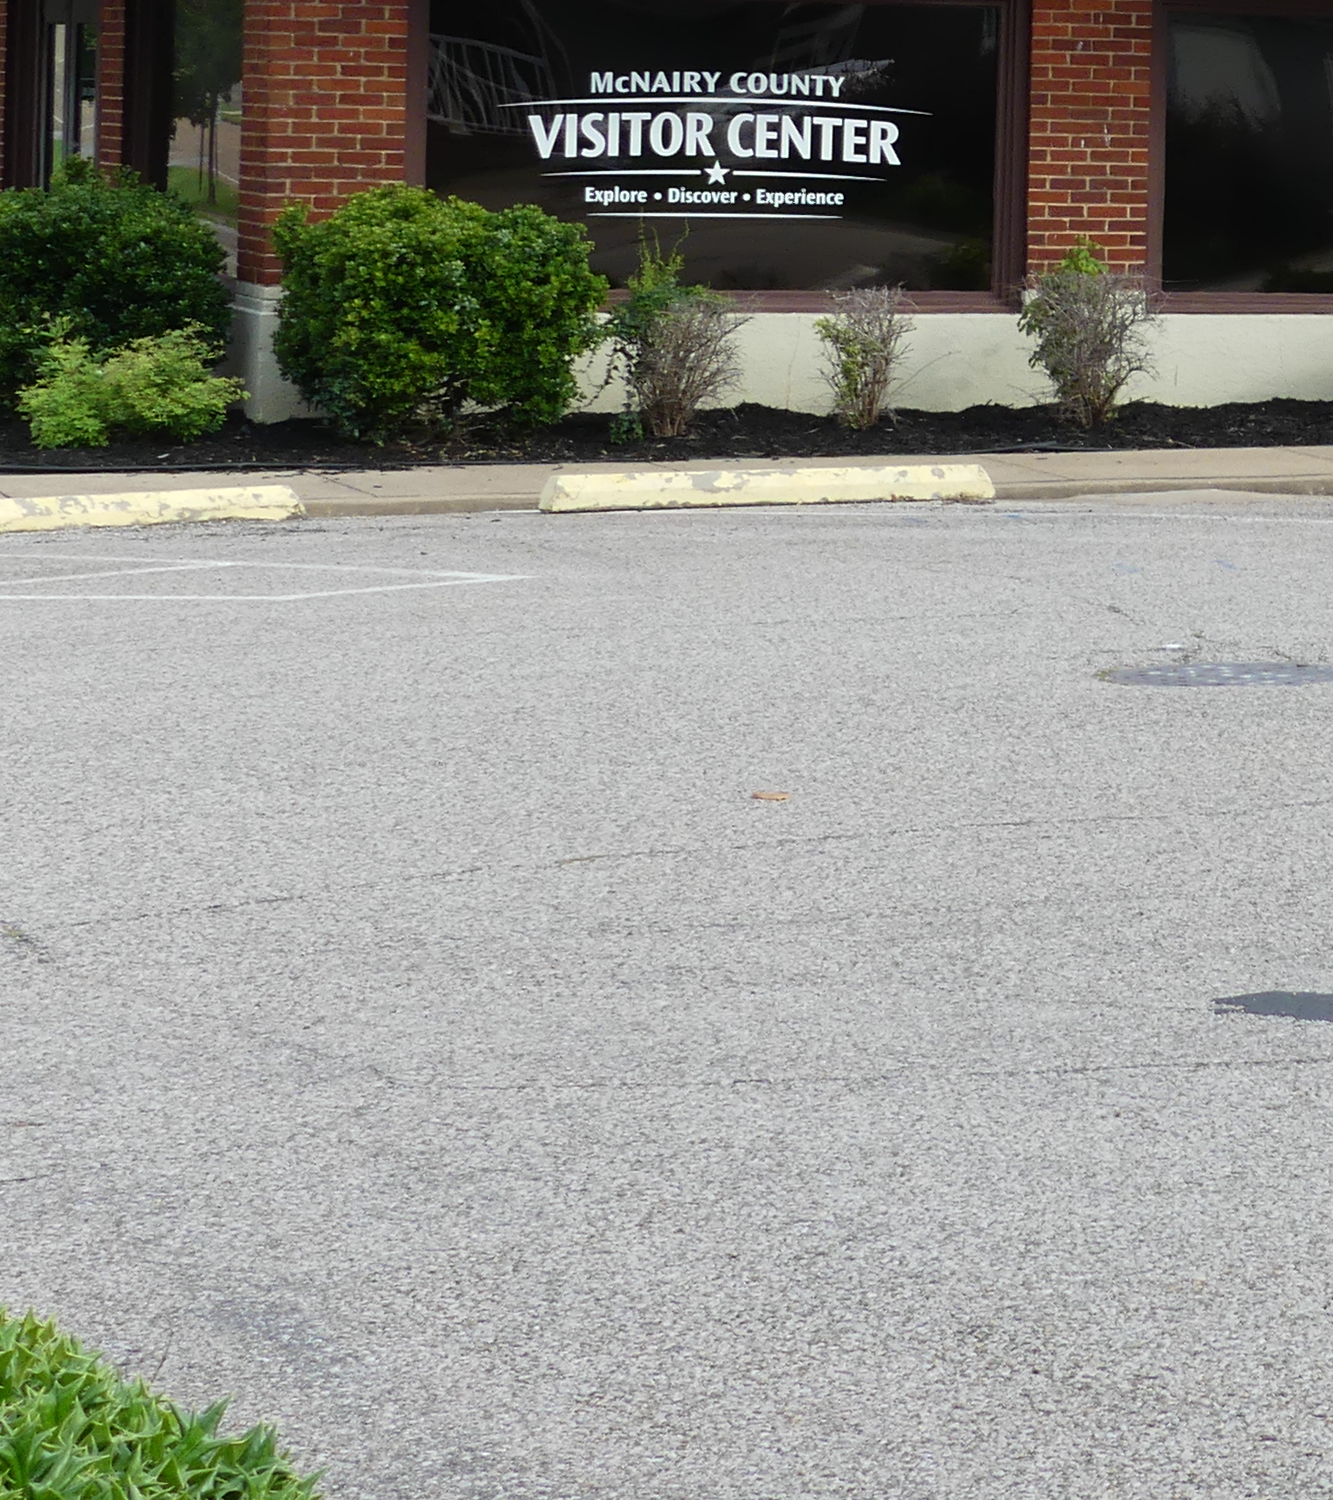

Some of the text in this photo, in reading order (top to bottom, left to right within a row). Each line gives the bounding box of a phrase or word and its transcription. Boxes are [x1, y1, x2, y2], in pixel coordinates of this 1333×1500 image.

[590, 71, 845, 97] McNAIRY COUNTY
[528, 112, 902, 166] VISITOR CENTER
[584, 186, 844, 207] Explore Discover Experience
